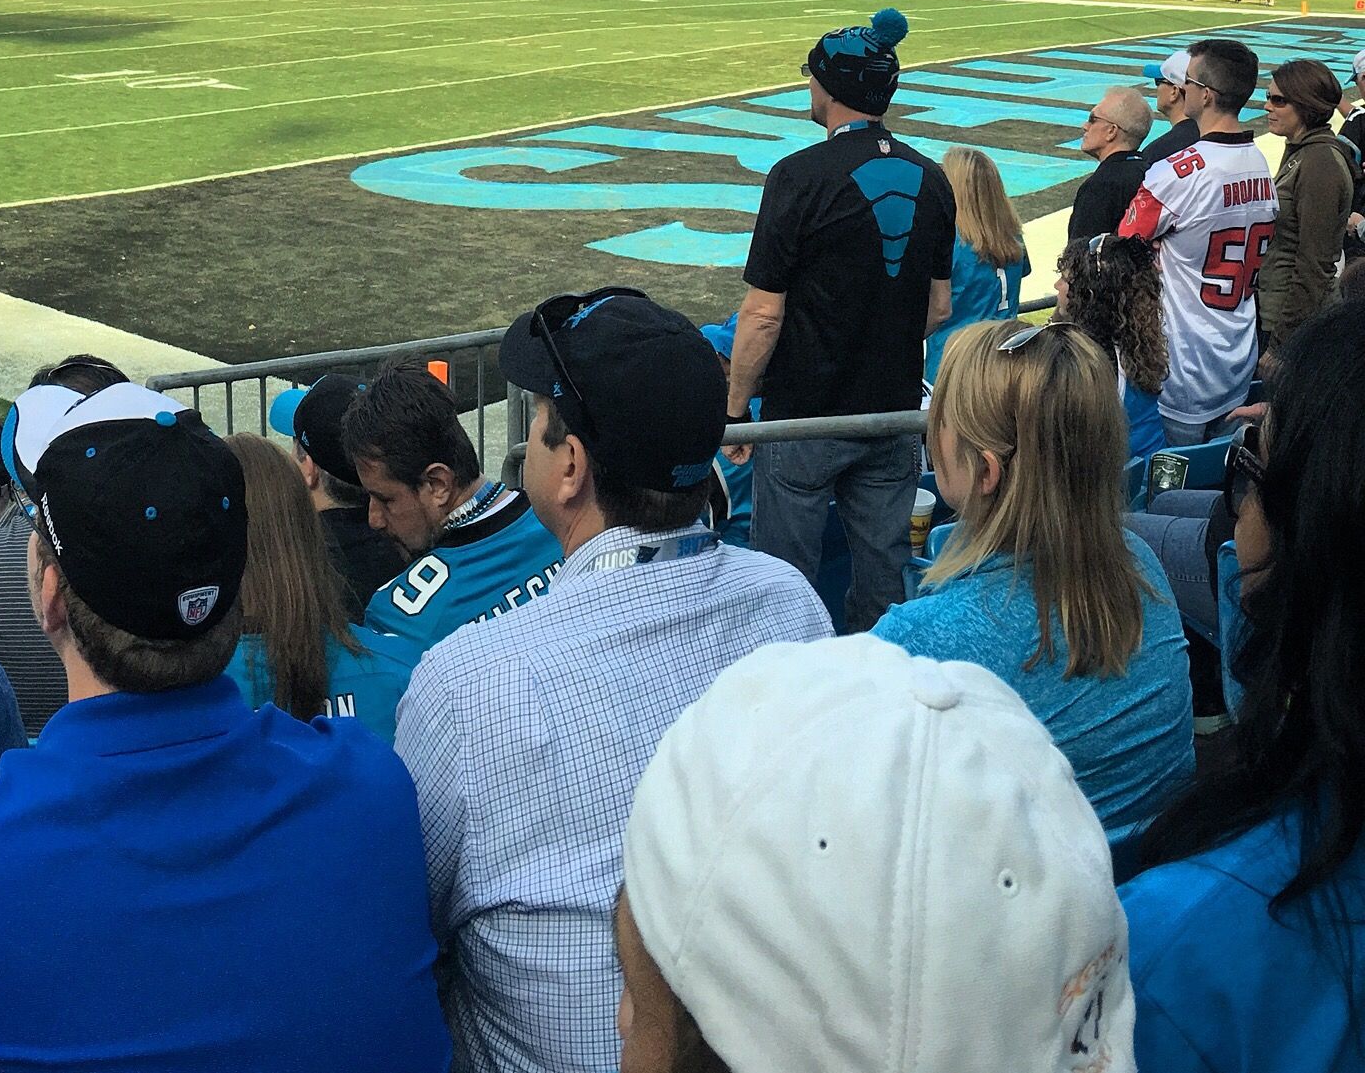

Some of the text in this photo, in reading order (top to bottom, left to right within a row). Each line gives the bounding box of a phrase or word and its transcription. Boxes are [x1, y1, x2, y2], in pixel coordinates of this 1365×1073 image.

[996, 266, 1010, 312] 1
[40, 491, 64, 557] Reebok
[182, 589, 217, 602] EQUIPMENT
[391, 554, 450, 616] 9
[188, 607, 205, 620] NFL
